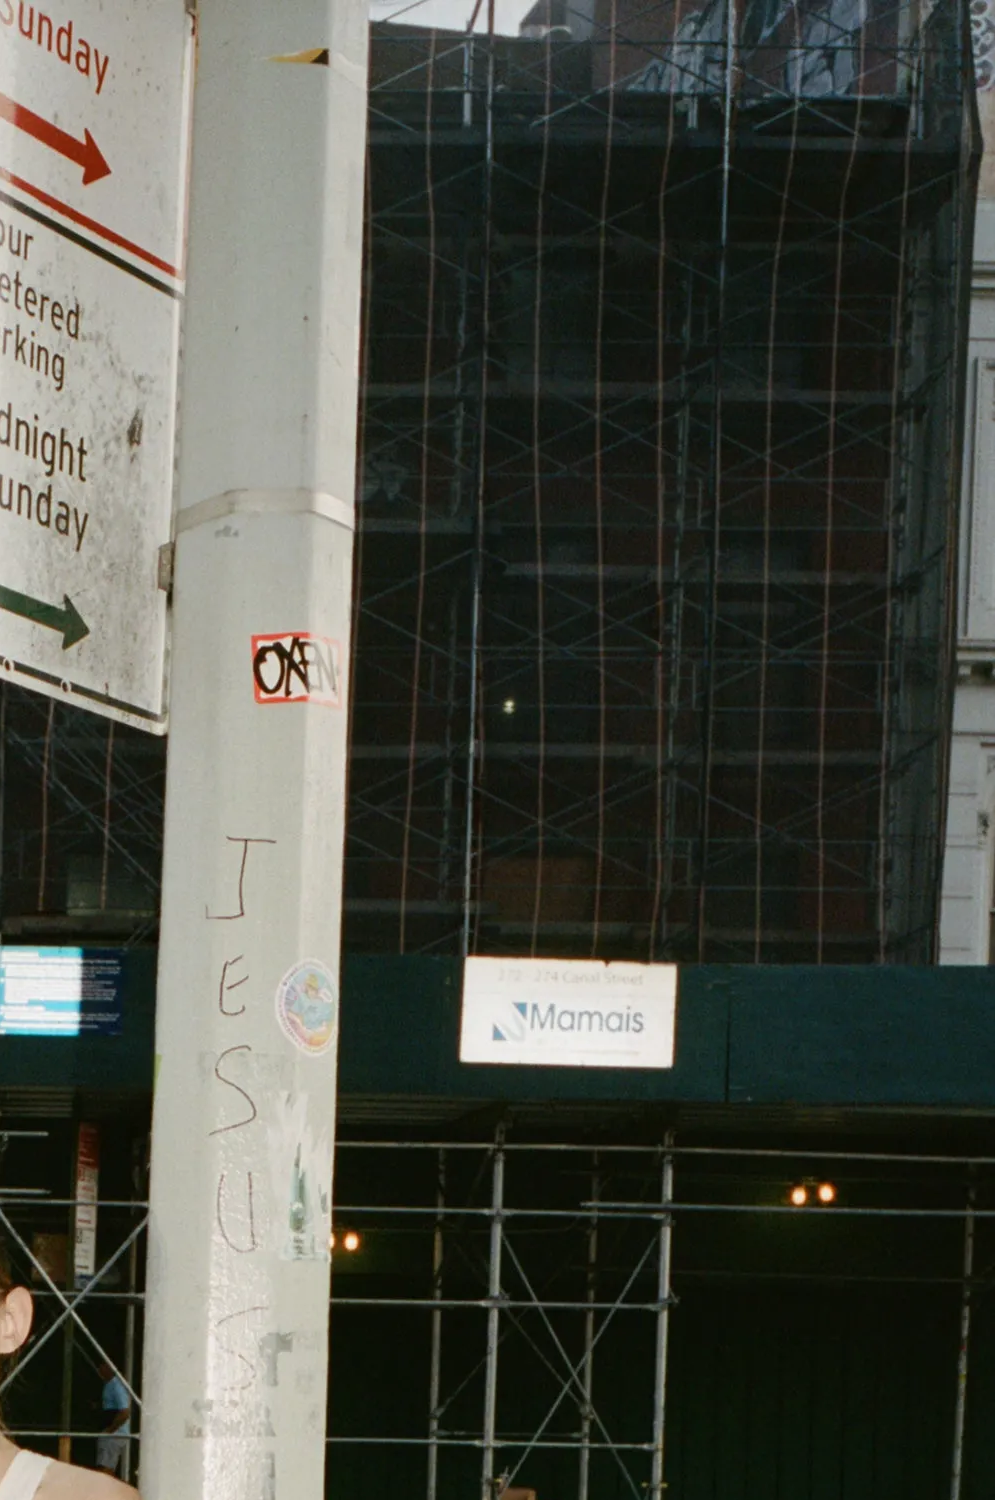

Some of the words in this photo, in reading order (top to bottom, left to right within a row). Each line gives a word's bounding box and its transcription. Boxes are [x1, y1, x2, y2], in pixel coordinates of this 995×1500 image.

[562, 970, 600, 984] Canal
[603, 970, 645, 986] Street
[529, 1002, 645, 1034] Mamais
